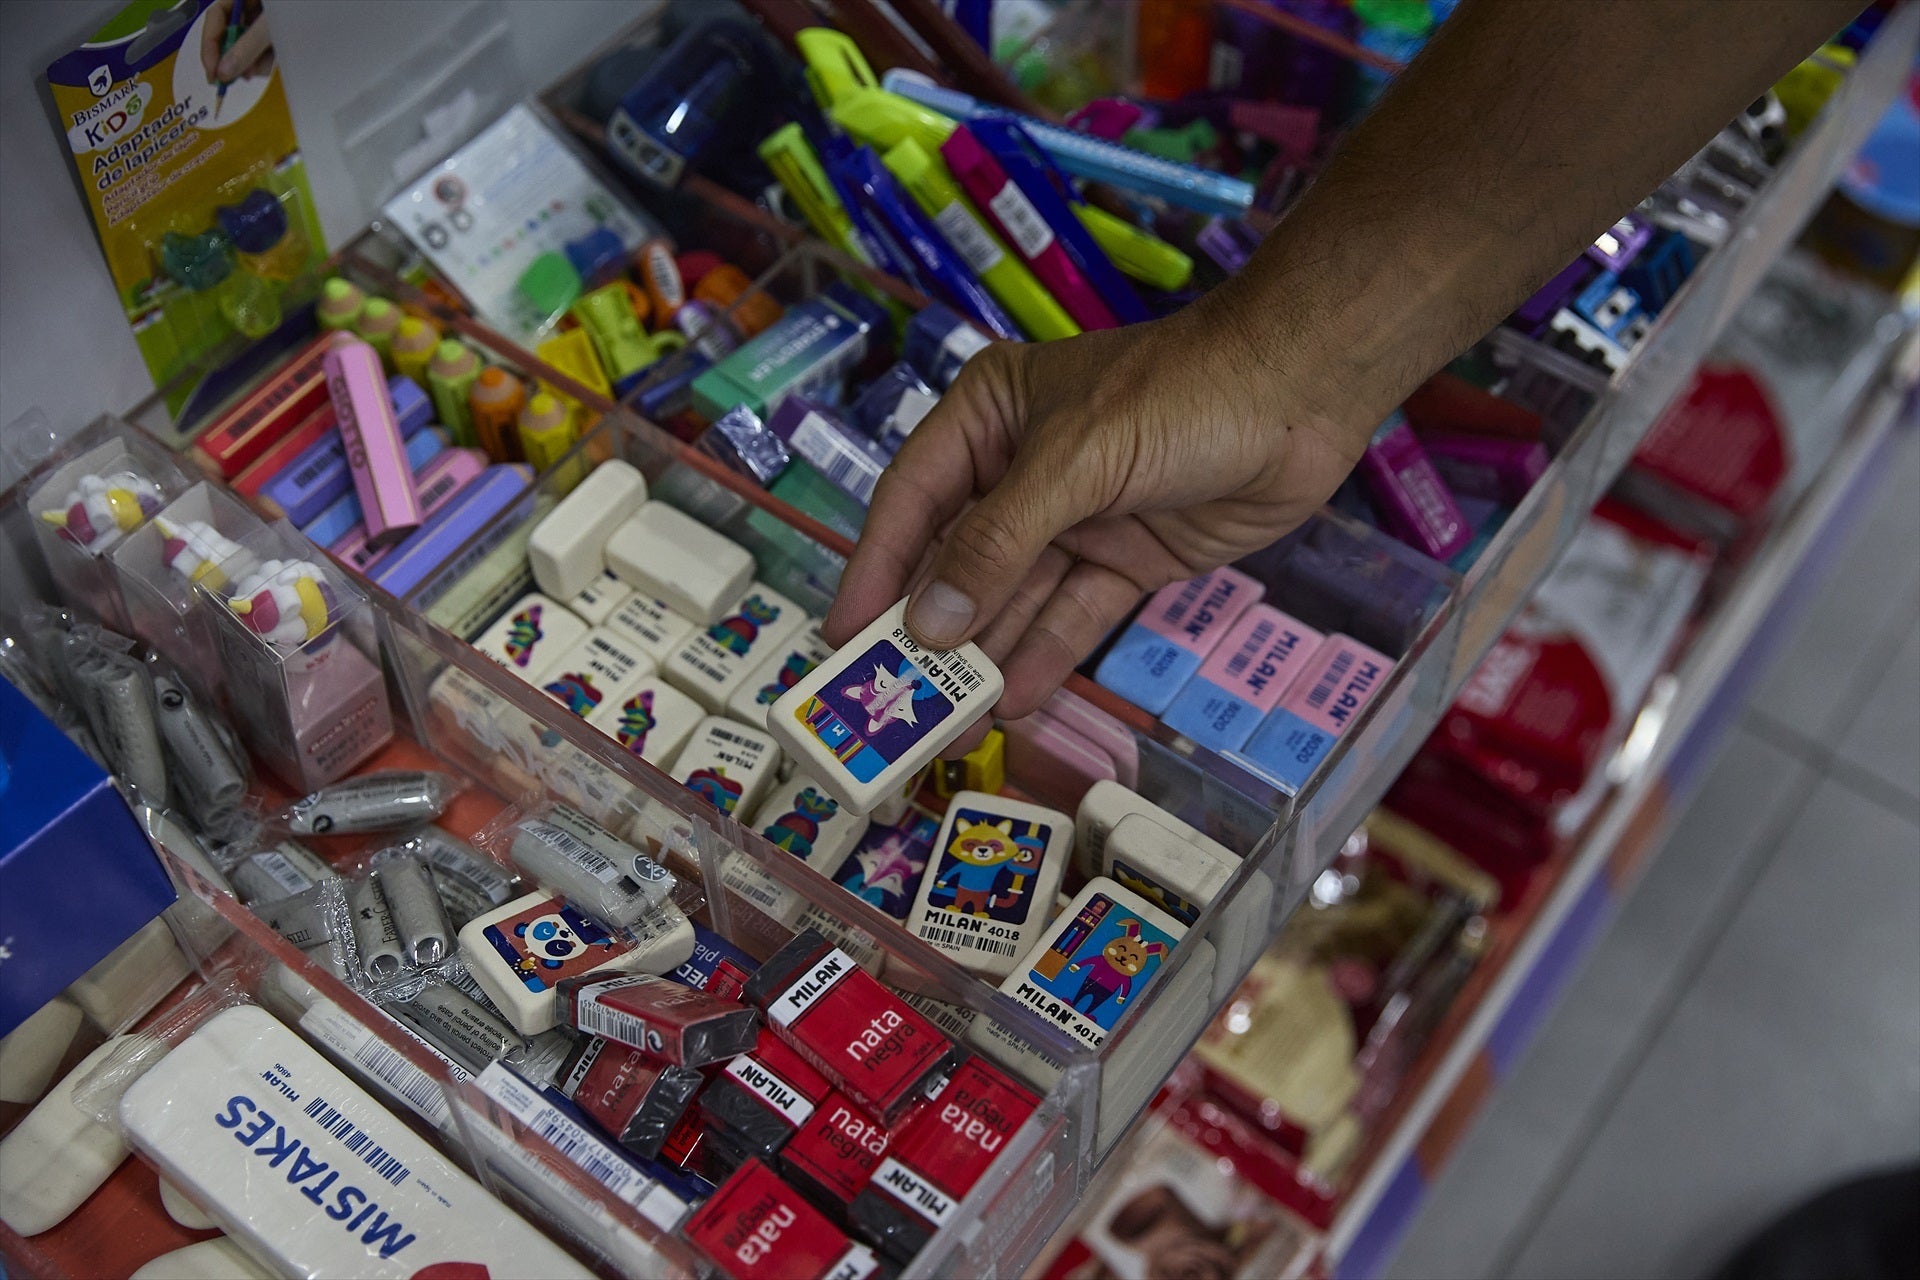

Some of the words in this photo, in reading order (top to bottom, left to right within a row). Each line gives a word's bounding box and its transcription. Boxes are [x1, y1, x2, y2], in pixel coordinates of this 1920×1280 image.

[94, 96, 192, 174] Adaptador
[98, 168, 123, 189] de
[125, 105, 208, 171] lapiceros
[1183, 579, 1237, 635] MILAN
[892, 627, 919, 653] 4018
[919, 655, 968, 703] MILAN
[1247, 630, 1300, 691] MILAN
[1328, 661, 1381, 724] MILAN
[1212, 701, 1242, 732] 8020
[717, 751, 754, 770] MILAN
[1296, 732, 1324, 764] 8020
[925, 910, 982, 933] MILAN
[987, 926, 1020, 941] 4018
[941, 943, 961, 952] SPAIN
[788, 960, 842, 1008] MILAN
[412, 1001, 430, 1017] avoid
[430, 1012, 443, 1025] and
[437, 1004, 453, 1018] case
[453, 1014, 472, 1031] pencil
[461, 1008, 485, 1031] erasing
[955, 1003, 976, 1023] 401
[1017, 983, 1072, 1025] MILAN
[451, 1028, 473, 1044] pencil
[471, 1026, 480, 1036] of
[846, 1009, 903, 1061] nata
[864, 1023, 915, 1072] negra
[1007, 1038, 1026, 1054] SPAIN
[274, 1063, 292, 1079] 4806
[470, 1042, 493, 1062] Protect
[572, 1037, 605, 1082] MILA
[262, 1070, 300, 1102] MILAN
[601, 1050, 641, 1107] nata
[740, 1064, 796, 1110] MILAN
[544, 1109, 586, 1140] 504598
[941, 1103, 1003, 1152] nata
[955, 1090, 1013, 1132] negra
[819, 1125, 873, 1169] negra
[829, 1106, 889, 1156] nata
[215, 1096, 416, 1259] MISTAKES
[585, 1140, 631, 1176] 007817
[634, 1178, 644, 1188] 4
[888, 1169, 948, 1216] MILAN
[724, 1193, 777, 1243] negra
[736, 1204, 797, 1265] nata
